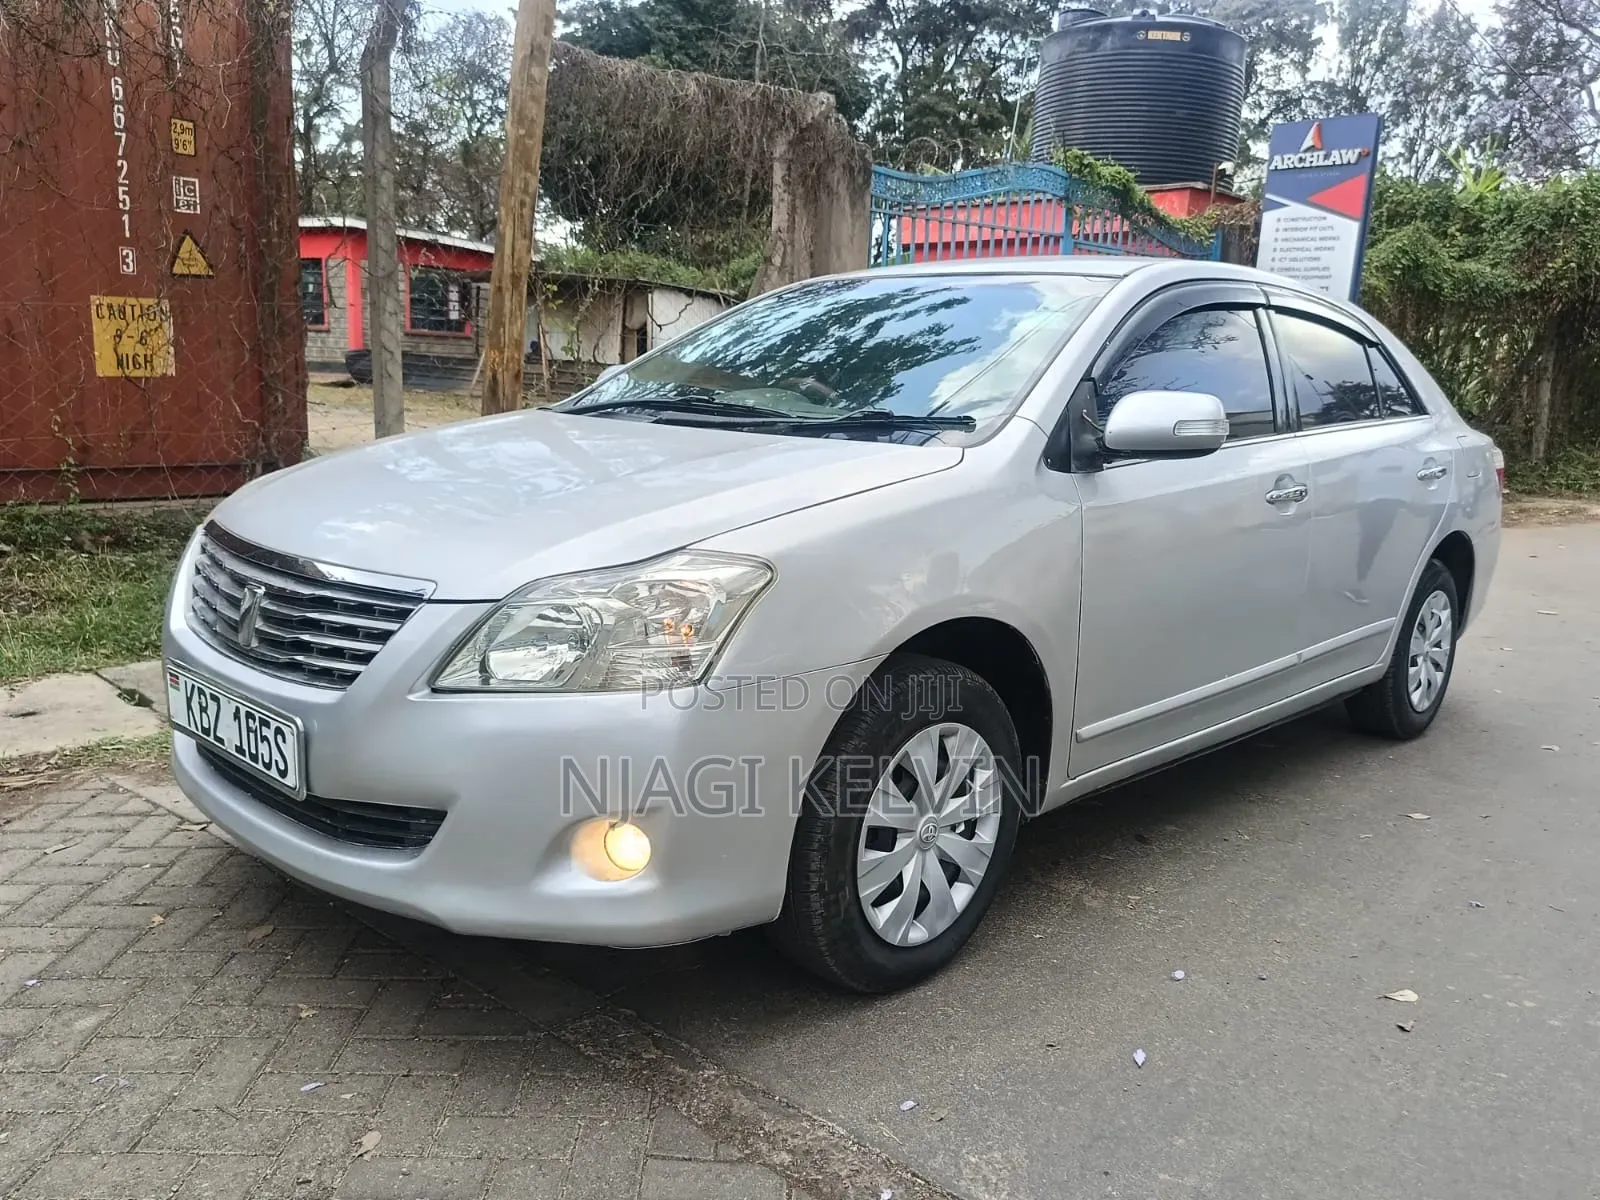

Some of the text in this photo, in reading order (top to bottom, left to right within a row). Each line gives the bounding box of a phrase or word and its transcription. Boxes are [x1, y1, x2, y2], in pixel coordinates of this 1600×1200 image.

[111, 76, 130, 239] 667251
[122, 249, 133, 273] 3
[1269, 148, 1360, 170] ARCHLAW
[184, 680, 226, 747] KBZ
